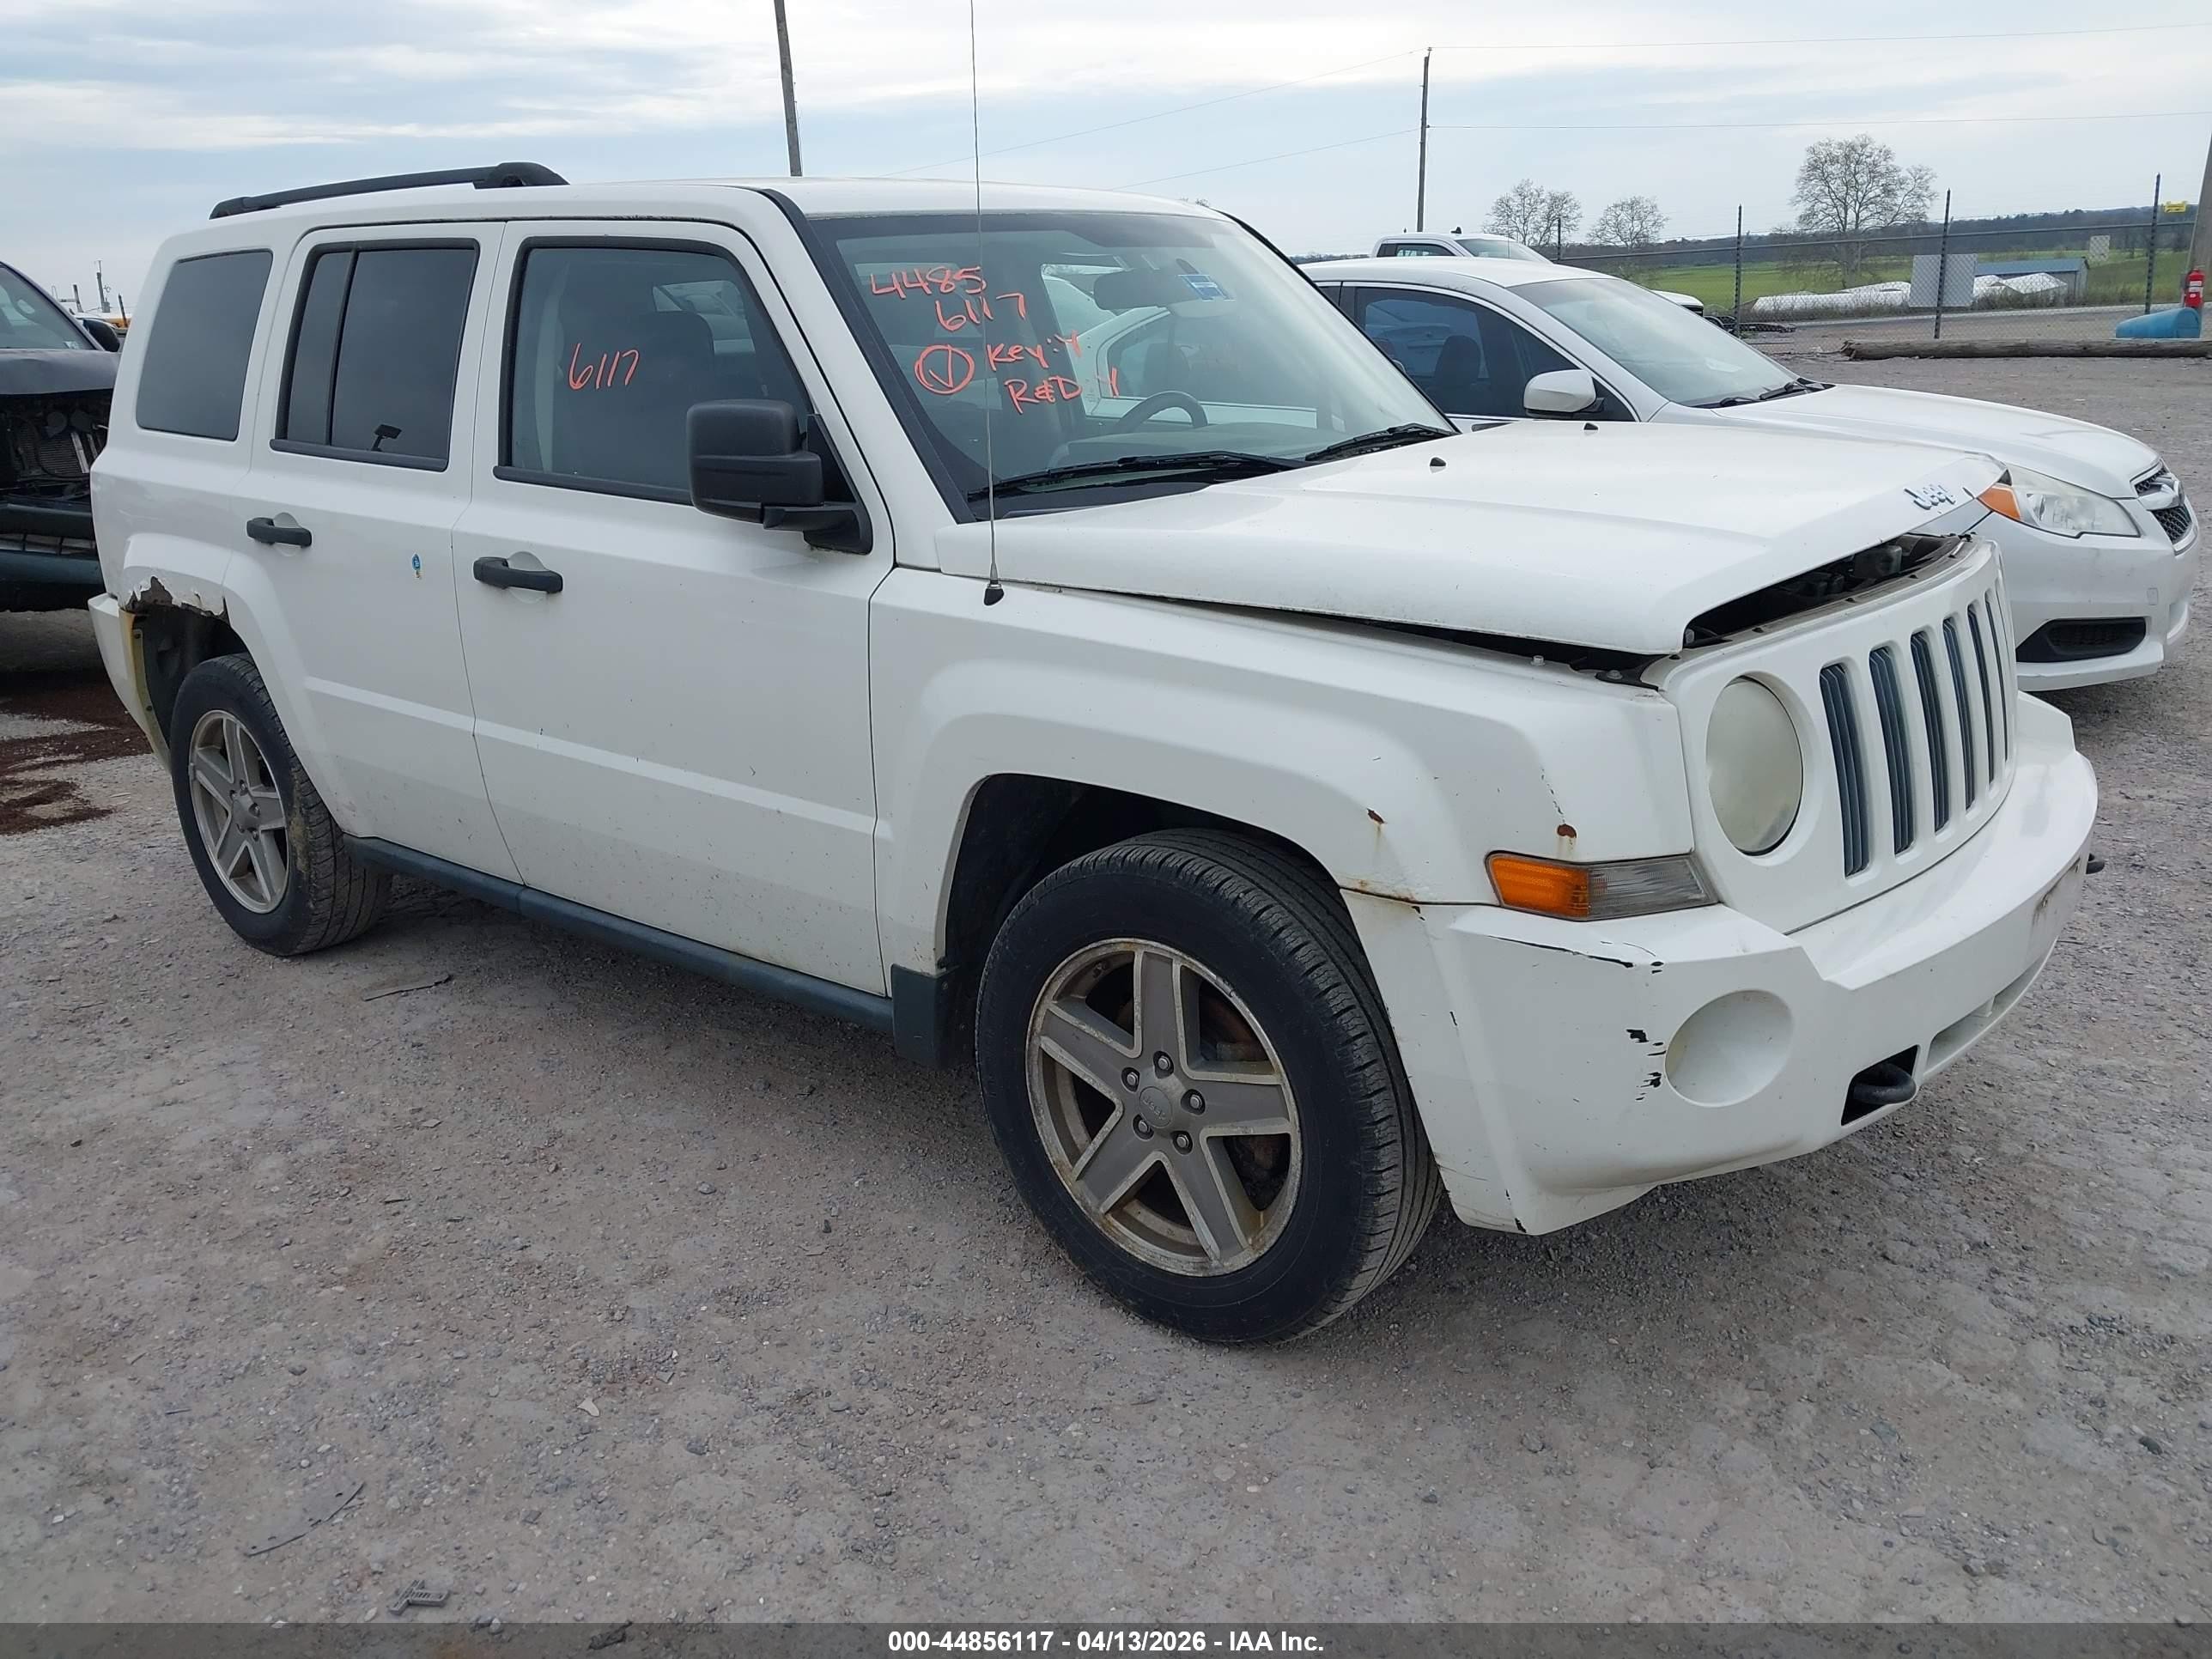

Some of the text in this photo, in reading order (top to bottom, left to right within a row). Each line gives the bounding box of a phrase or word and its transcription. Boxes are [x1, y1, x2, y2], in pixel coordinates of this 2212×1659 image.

[869, 265, 988, 300] 4485
[933, 291, 1026, 332] 6117
[568, 342, 641, 390] 6117
